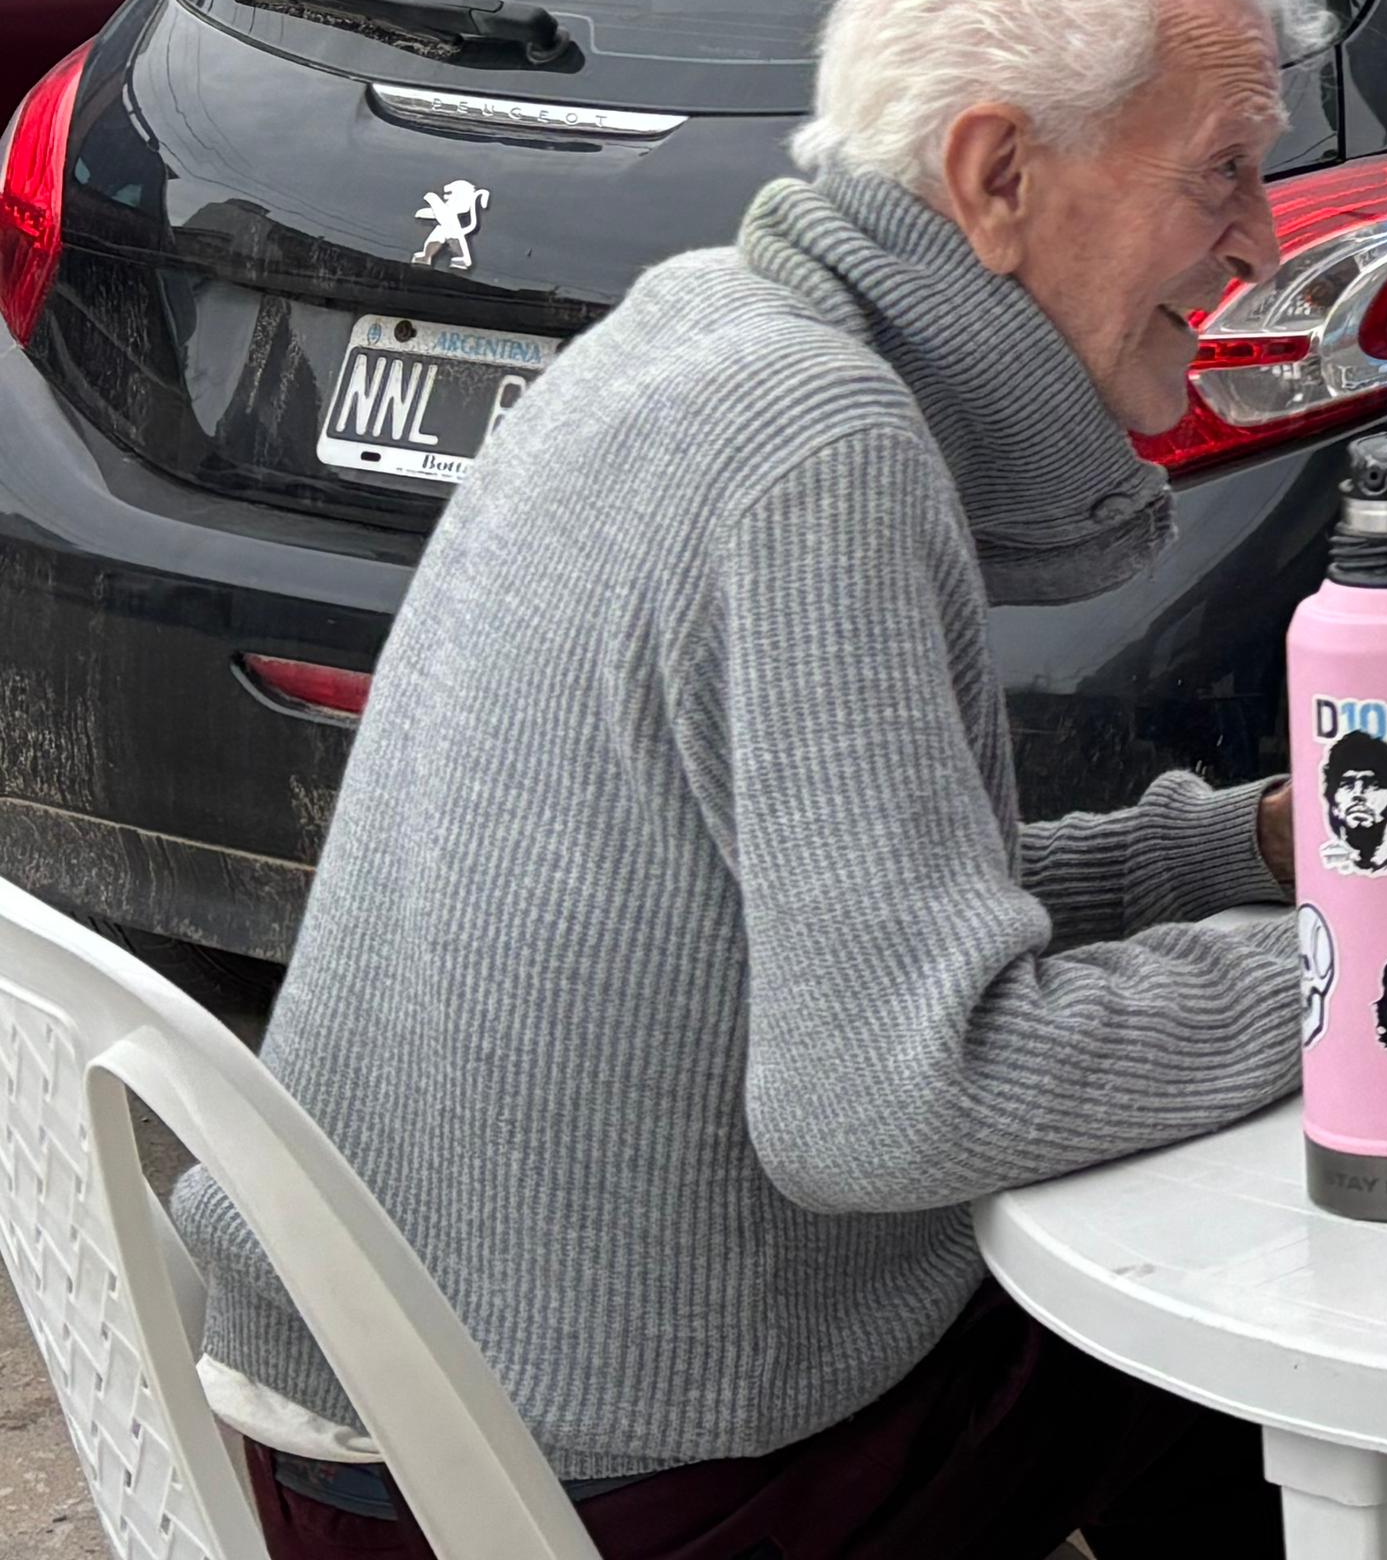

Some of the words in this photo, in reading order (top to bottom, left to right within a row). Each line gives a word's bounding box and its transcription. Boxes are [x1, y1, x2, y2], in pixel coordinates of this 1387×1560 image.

[430, 97, 609, 128] PEUGEOT
[433, 330, 542, 365] ARGENTINA
[335, 353, 439, 446] NNL
